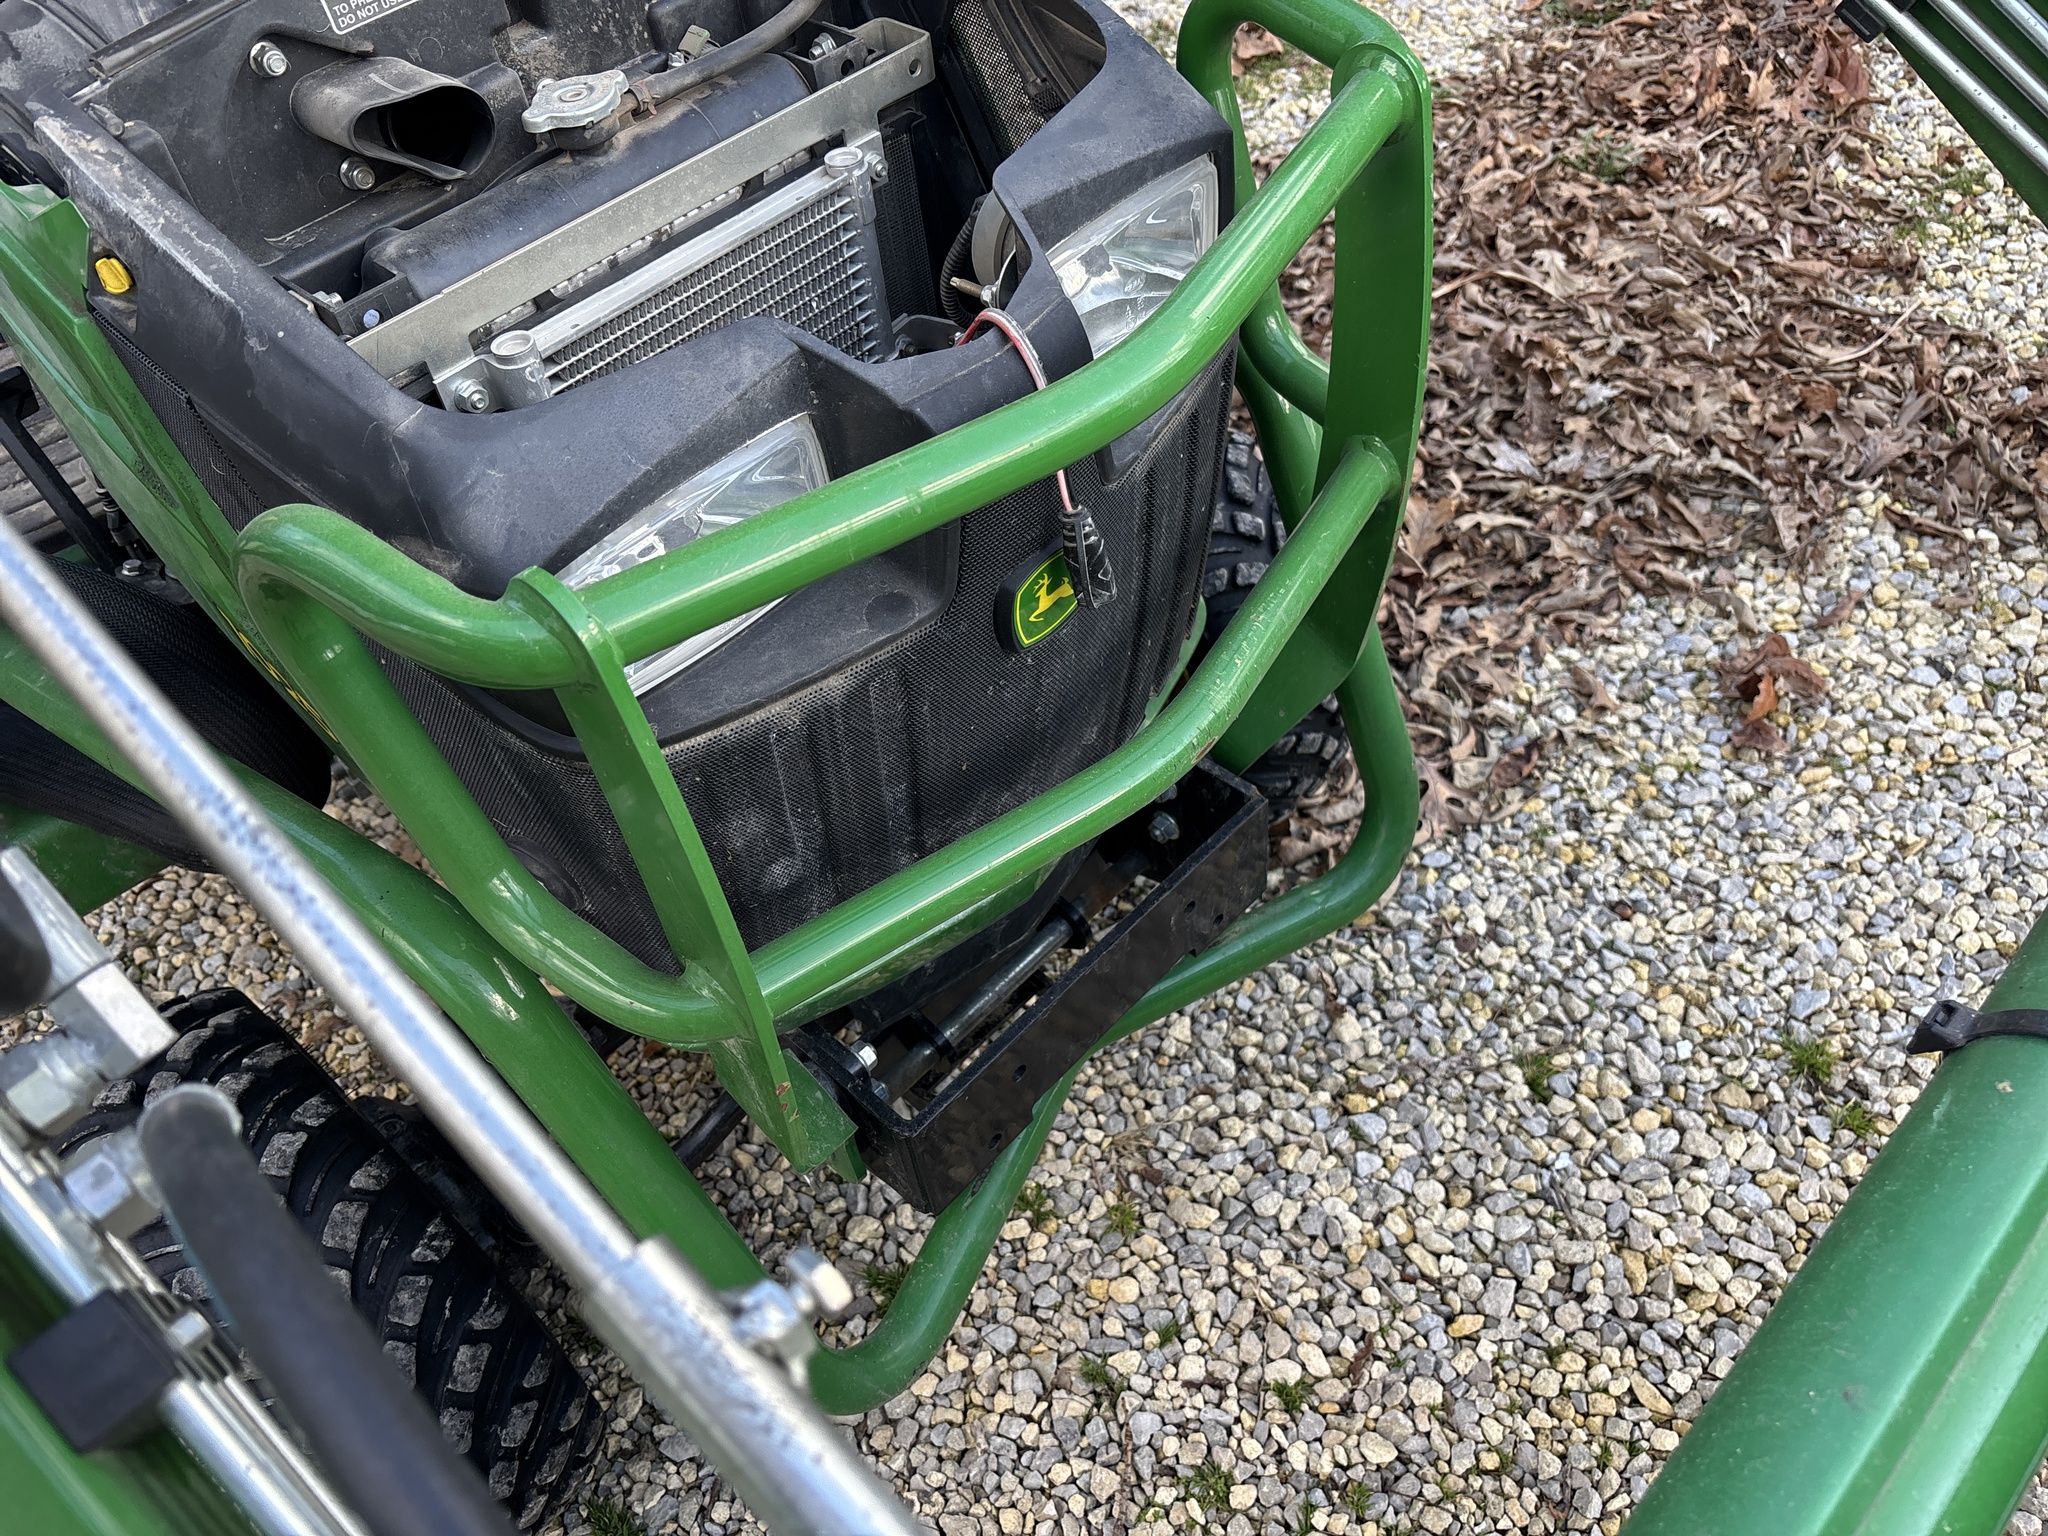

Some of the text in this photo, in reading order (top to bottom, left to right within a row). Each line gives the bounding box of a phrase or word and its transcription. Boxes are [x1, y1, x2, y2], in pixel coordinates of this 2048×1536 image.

[332, 3, 349, 16] TO
[338, 0, 403, 28] DO NOT US
